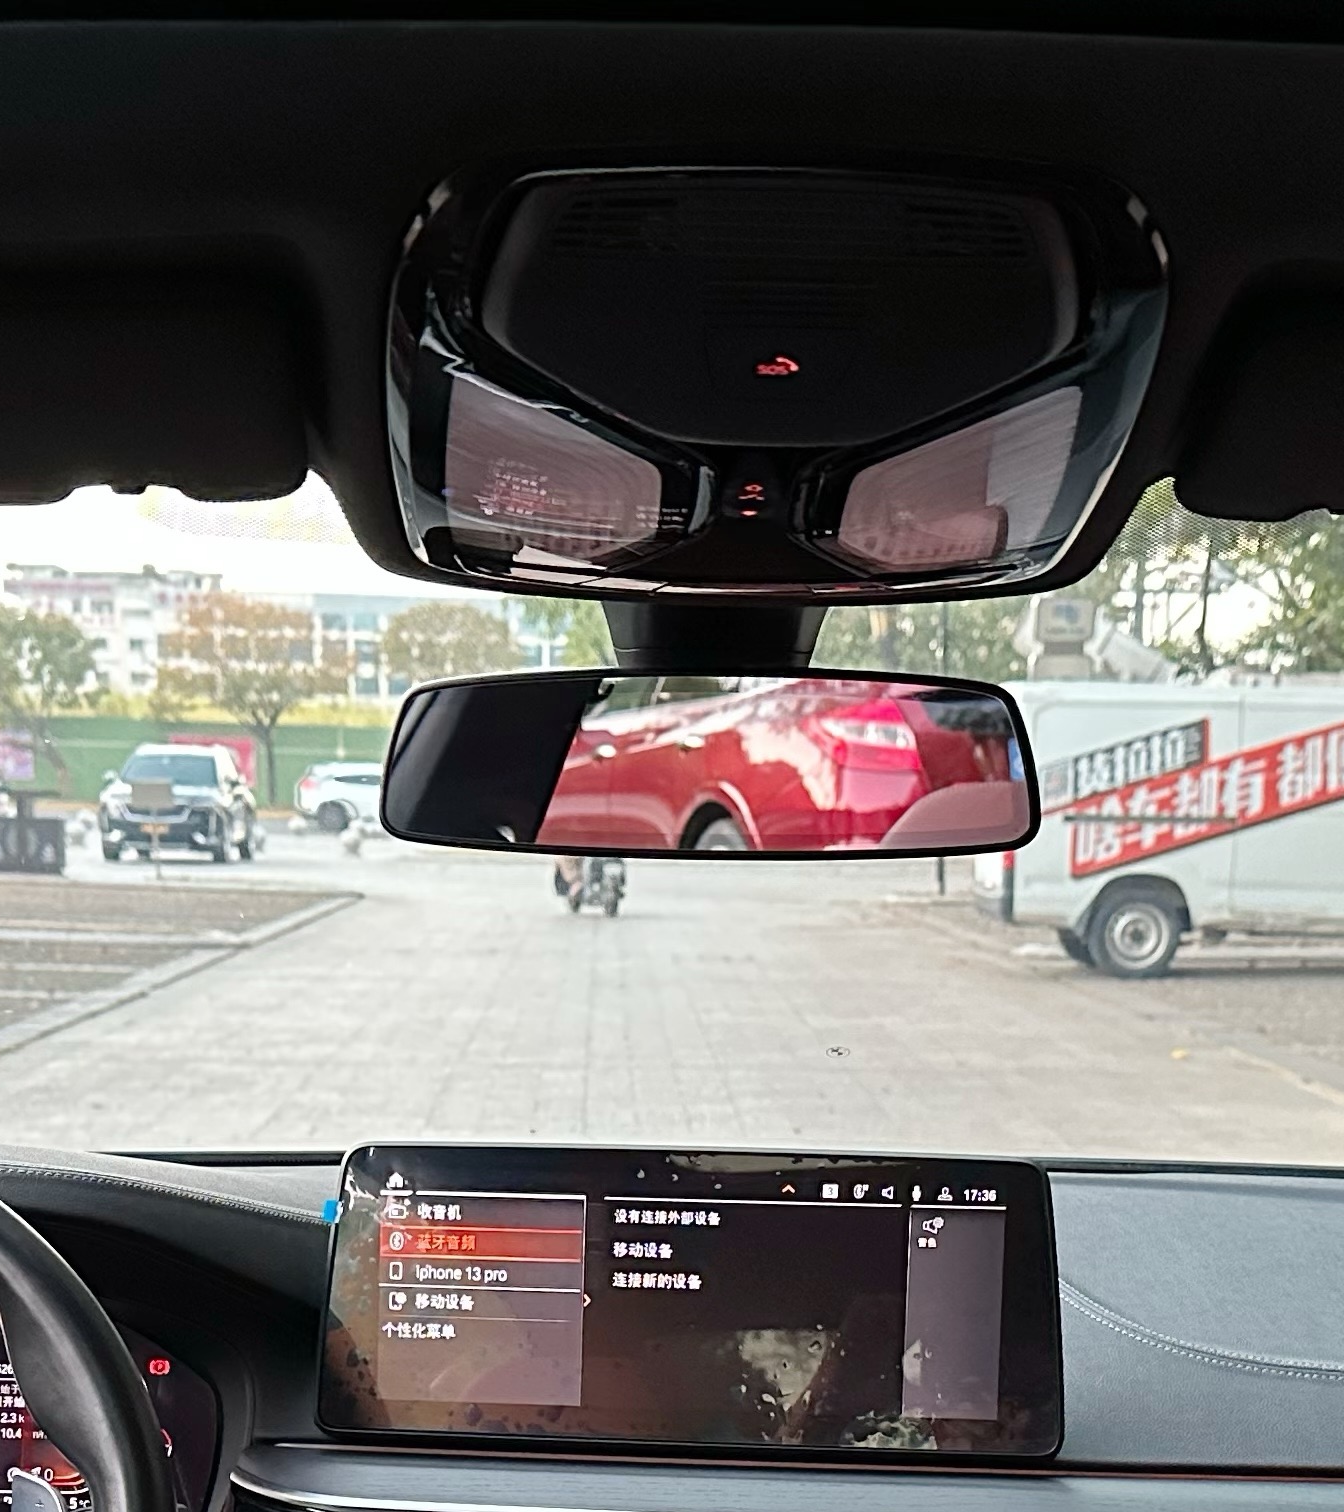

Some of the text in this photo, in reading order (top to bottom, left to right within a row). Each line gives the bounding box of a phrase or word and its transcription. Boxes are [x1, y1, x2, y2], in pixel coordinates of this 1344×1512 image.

[756, 364, 789, 375] SOS
[963, 1188, 997, 1202] 17:36
[417, 1202, 462, 1221] 收音机
[416, 1233, 477, 1252] 蓝牙音频
[613, 1241, 674, 1259] 移动设备
[465, 1266, 482, 1281] 13
[484, 1269, 508, 1283] pro
[612, 1272, 702, 1290] 连接新的设备
[414, 1292, 475, 1311] 移动设备
[381, 1322, 456, 1340] 个性化菜单
[0, 1412, 17, 1424] 2.3
[0, 1427, 23, 1439] 10.4
